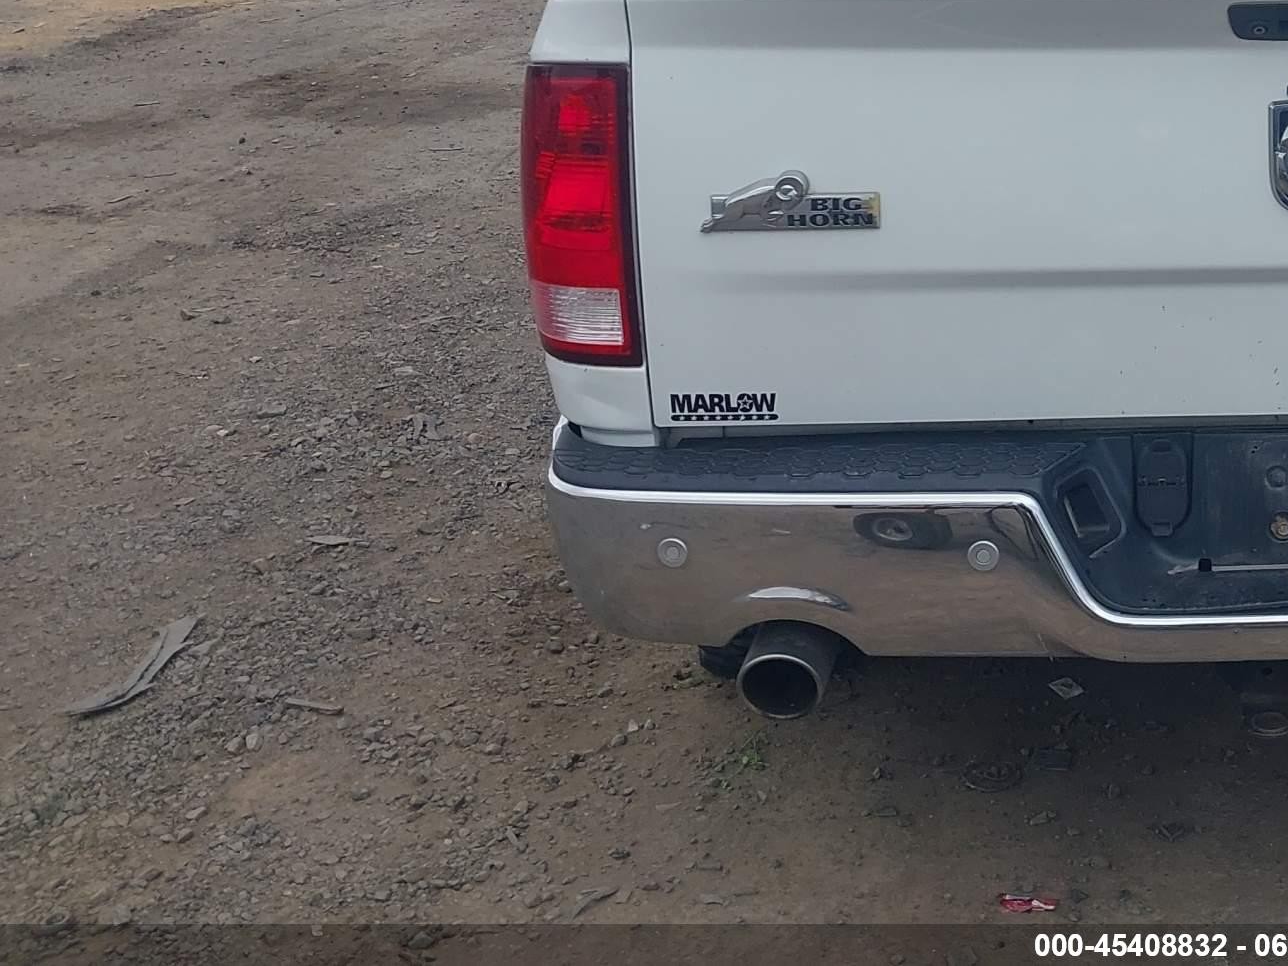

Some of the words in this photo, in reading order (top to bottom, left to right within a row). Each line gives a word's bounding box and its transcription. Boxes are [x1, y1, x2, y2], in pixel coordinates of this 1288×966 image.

[810, 197, 863, 212] BIG
[786, 212, 874, 227] HORN
[670, 392, 777, 413] MARLOW
